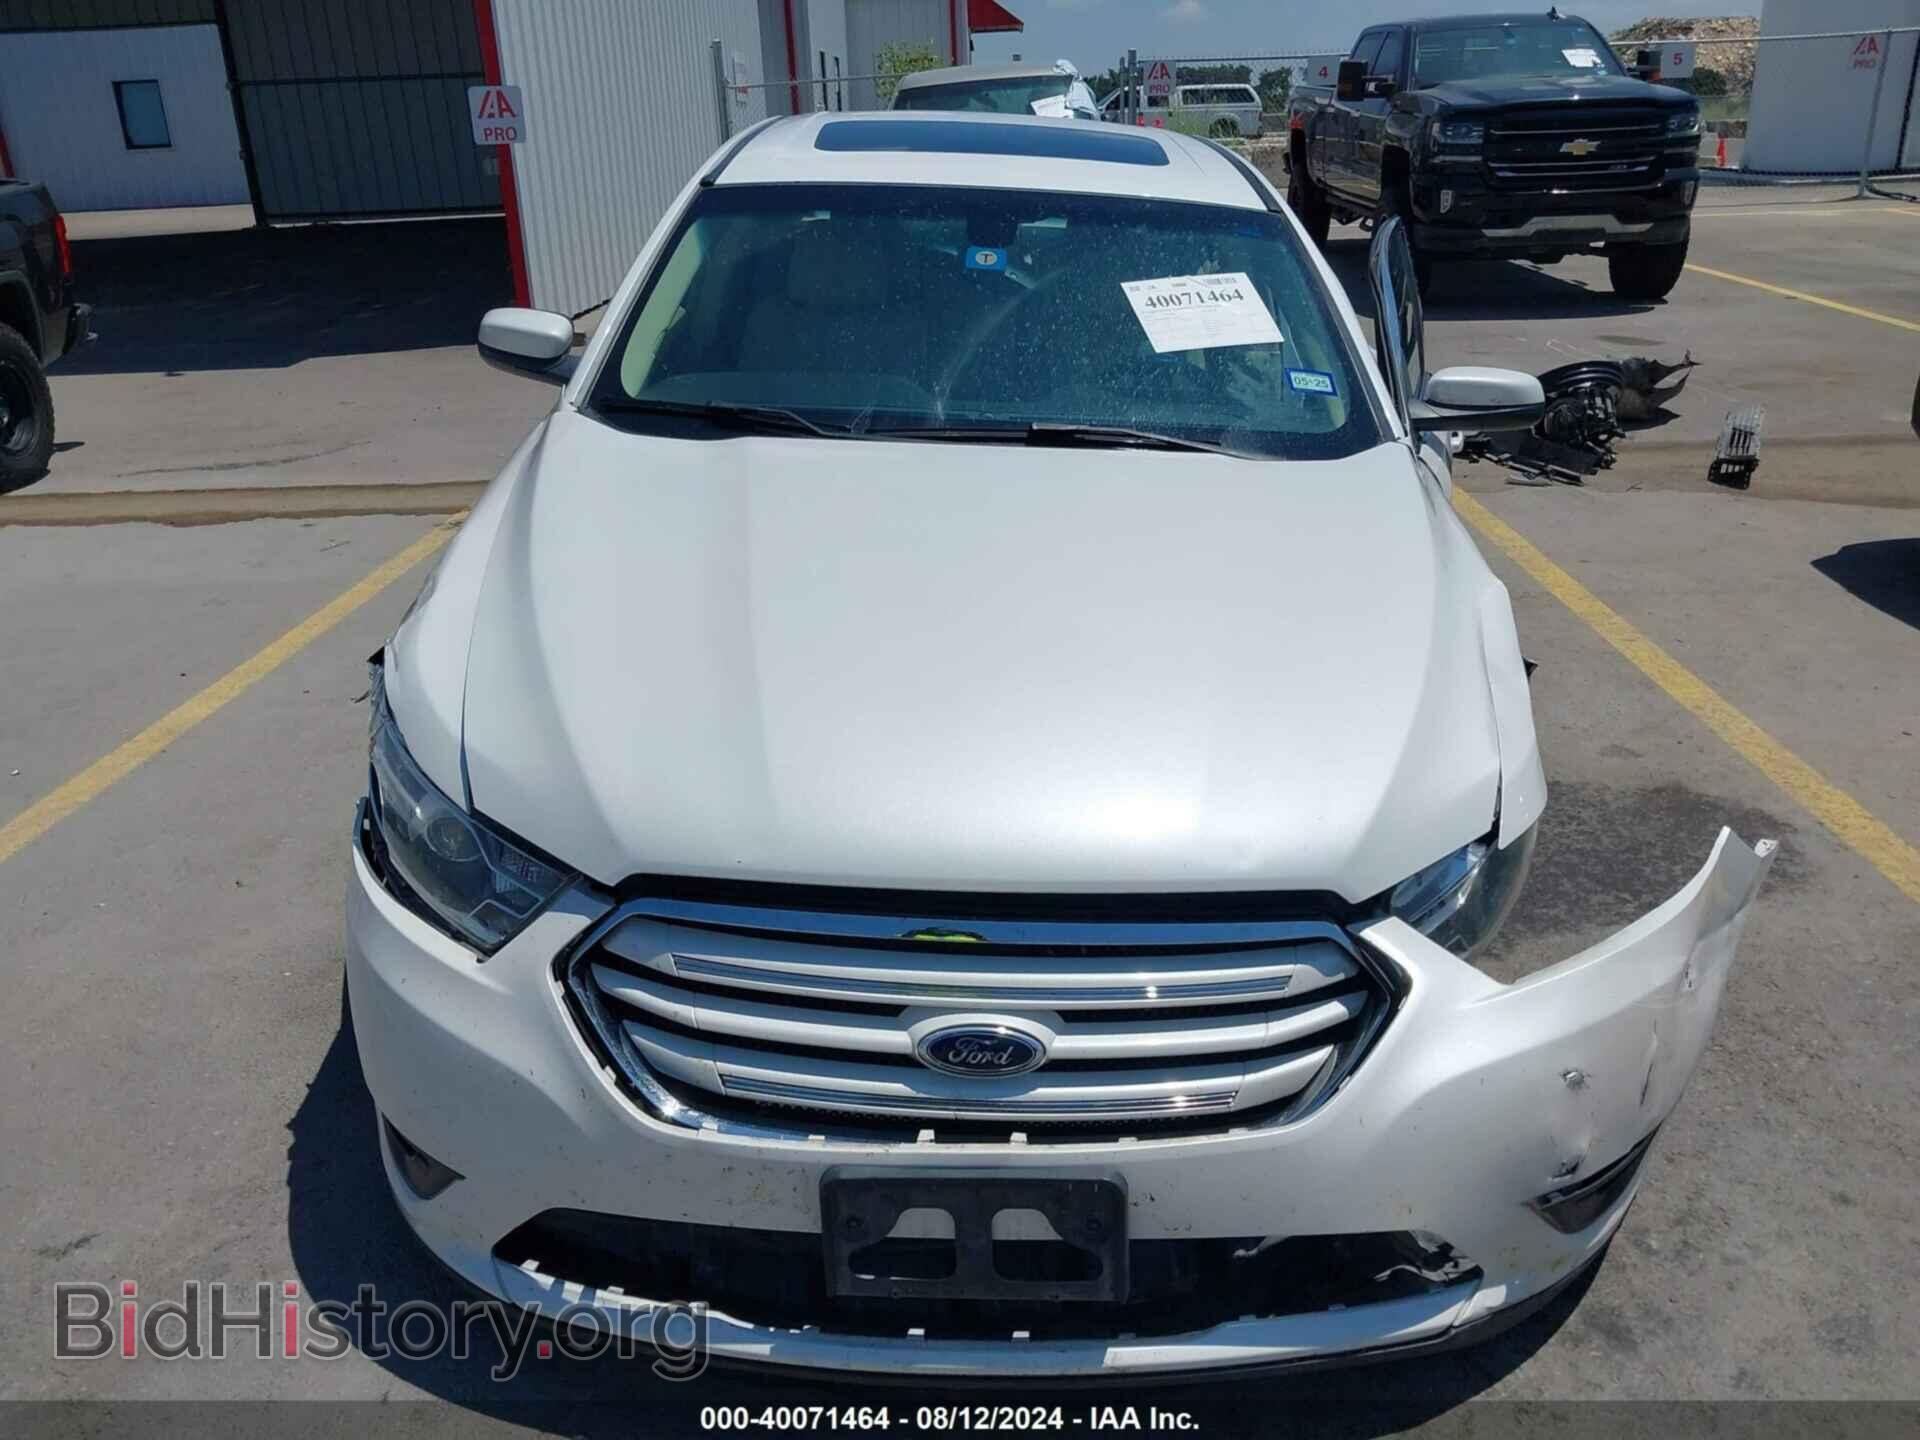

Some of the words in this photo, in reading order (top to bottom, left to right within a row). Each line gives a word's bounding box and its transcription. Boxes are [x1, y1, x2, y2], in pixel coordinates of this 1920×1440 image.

[1673, 53, 1684, 66] 5
[1318, 65, 1329, 79] 4
[483, 127, 517, 141] PRO
[1144, 288, 1244, 309] 40071464
[948, 1037, 1014, 1065] Ford
